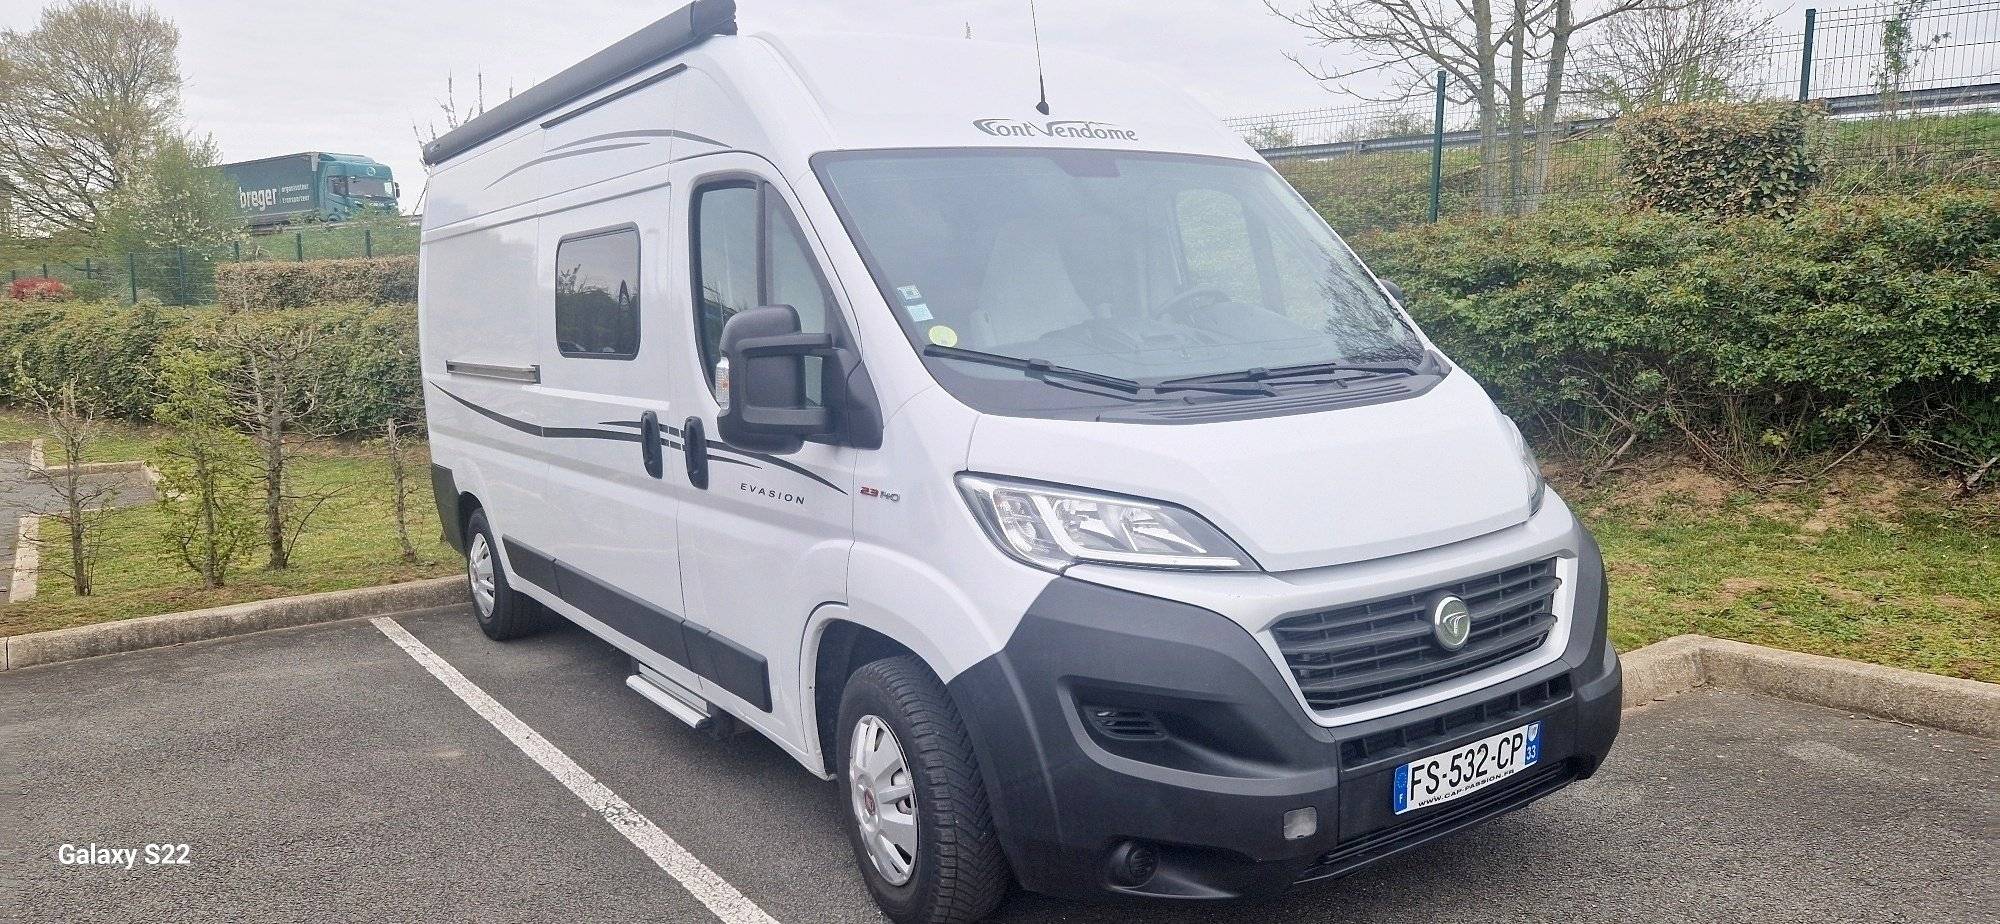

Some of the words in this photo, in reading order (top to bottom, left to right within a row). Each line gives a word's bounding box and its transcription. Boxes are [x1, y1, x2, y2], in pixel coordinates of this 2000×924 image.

[239, 186, 277, 211] breger
[740, 482, 805, 505] EVASION
[1525, 745, 1537, 761] 33
[1410, 732, 1523, 801] FS-532-CP
